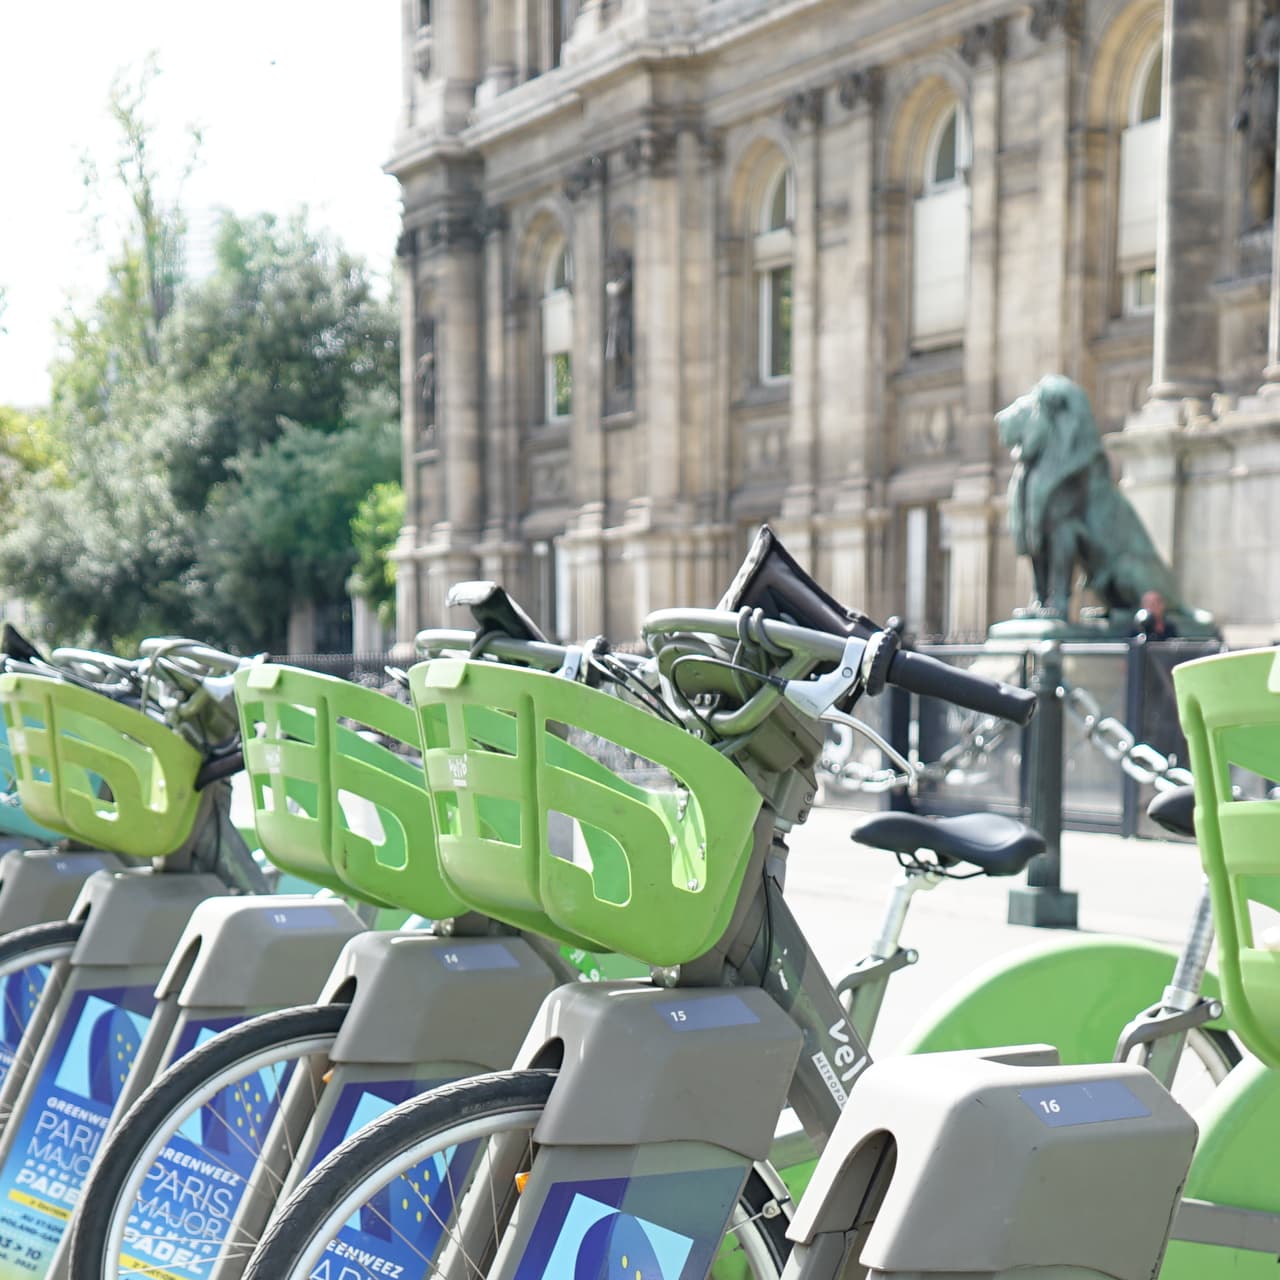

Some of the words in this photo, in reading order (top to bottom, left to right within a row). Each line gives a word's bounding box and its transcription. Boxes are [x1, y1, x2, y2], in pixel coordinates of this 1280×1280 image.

[444, 953, 459, 964] 14
[670, 1010, 687, 1022] 15
[828, 1018, 867, 1082] vel
[815, 1055, 847, 1109] MÉTROPOL
[47, 1097, 111, 1129] GREENWE
[1040, 1099, 1060, 1114] 16
[35, 1110, 101, 1156] PARI
[27, 1135, 92, 1177] MAJO
[158, 1146, 241, 1187] REENWEEZ
[15, 1168, 82, 1206] PADE
[325, 1239, 406, 1279] EENWEEZ
